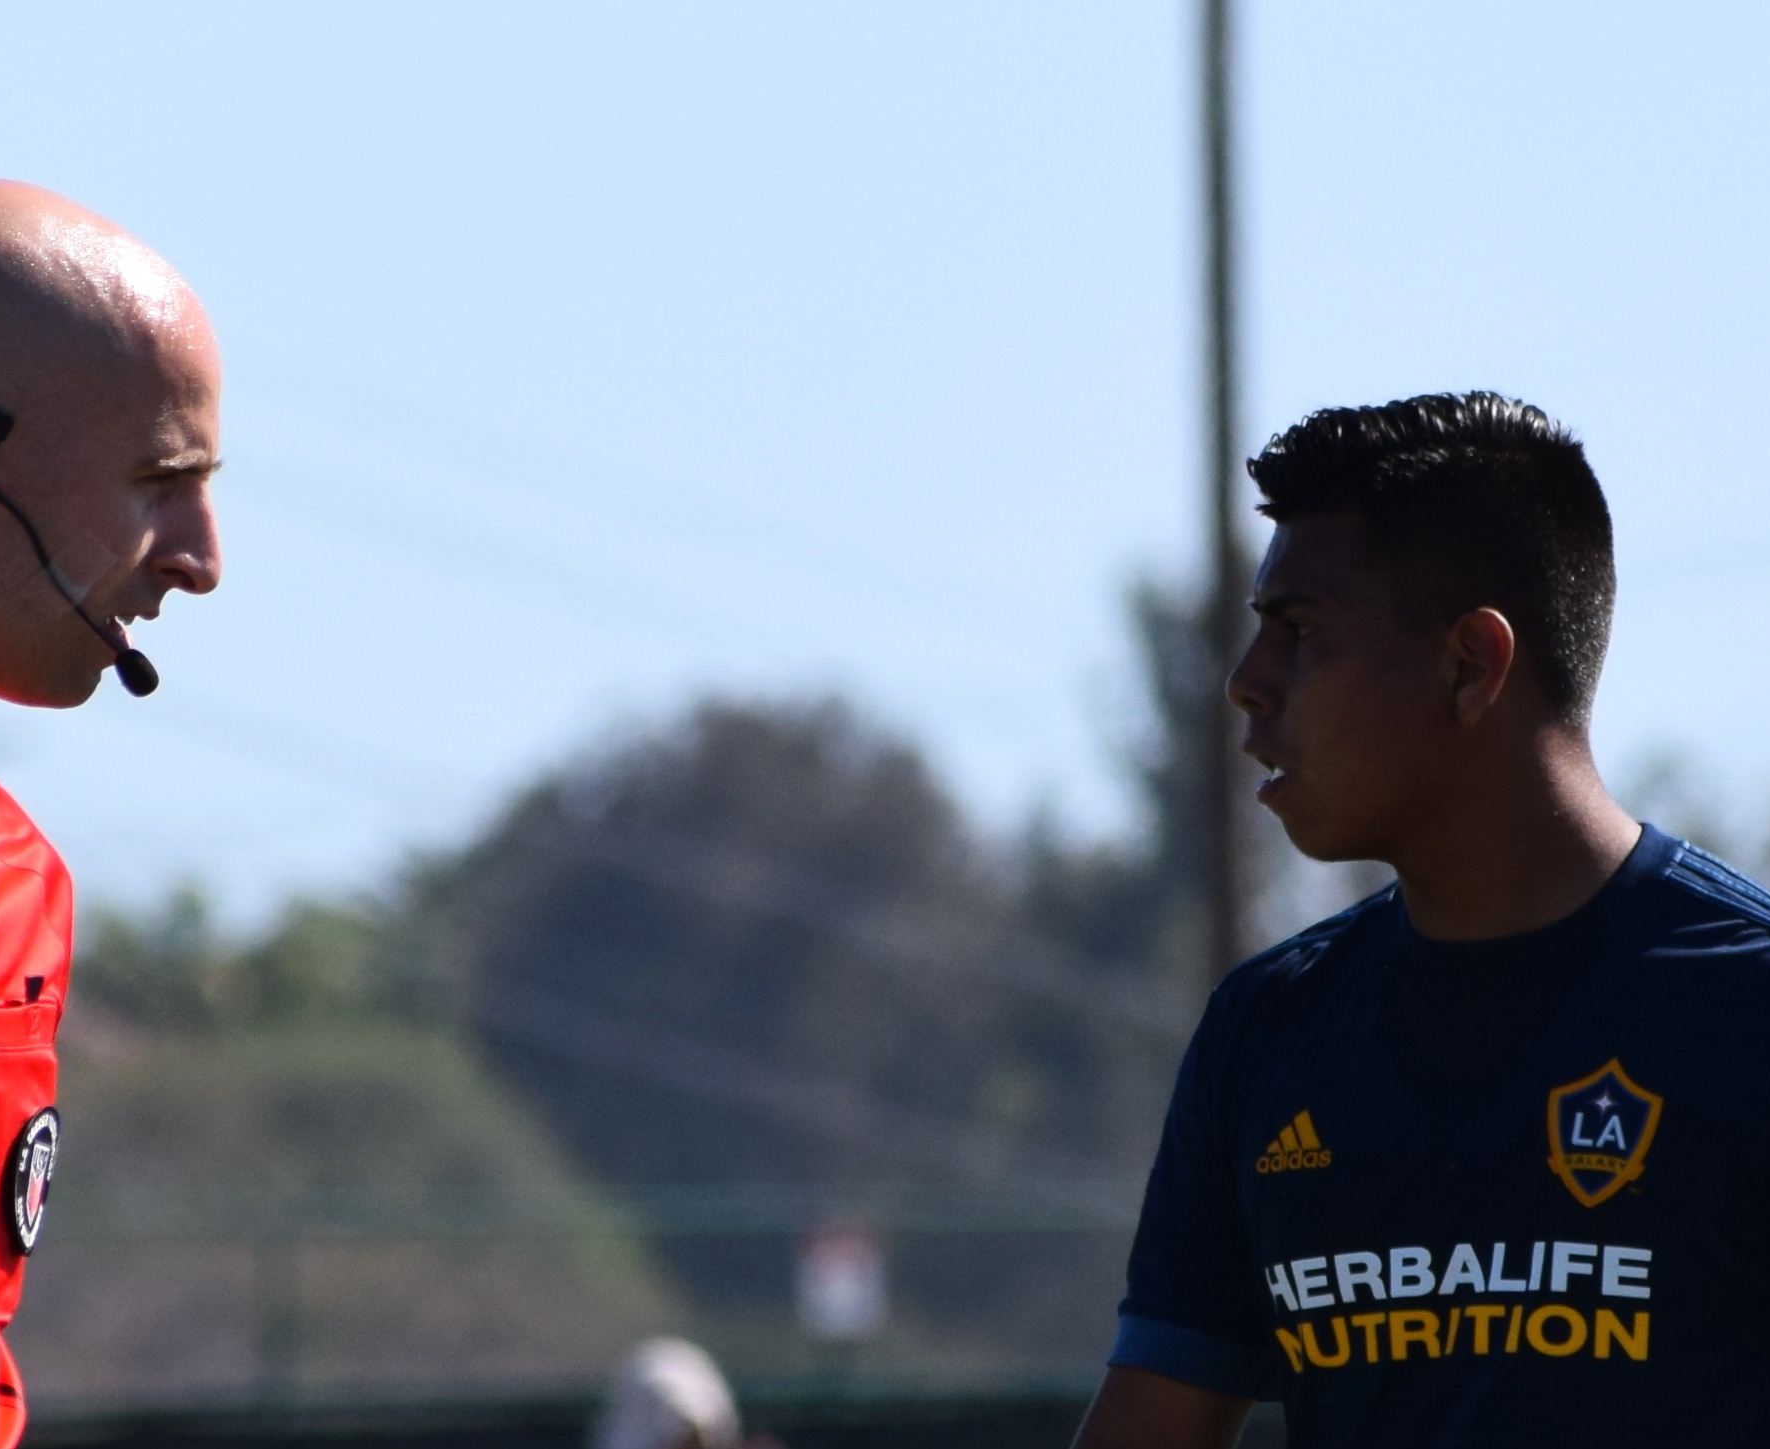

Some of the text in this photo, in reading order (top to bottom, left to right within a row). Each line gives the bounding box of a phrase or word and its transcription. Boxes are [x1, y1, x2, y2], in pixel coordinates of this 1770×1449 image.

[1571, 1111, 1627, 1151] LA
[1256, 1147, 1332, 1173] adidas
[1562, 1154, 1629, 1172] GALAXY
[1265, 1240, 1652, 1312] HERBALIFE
[1276, 1303, 1651, 1374] NUTRITION
